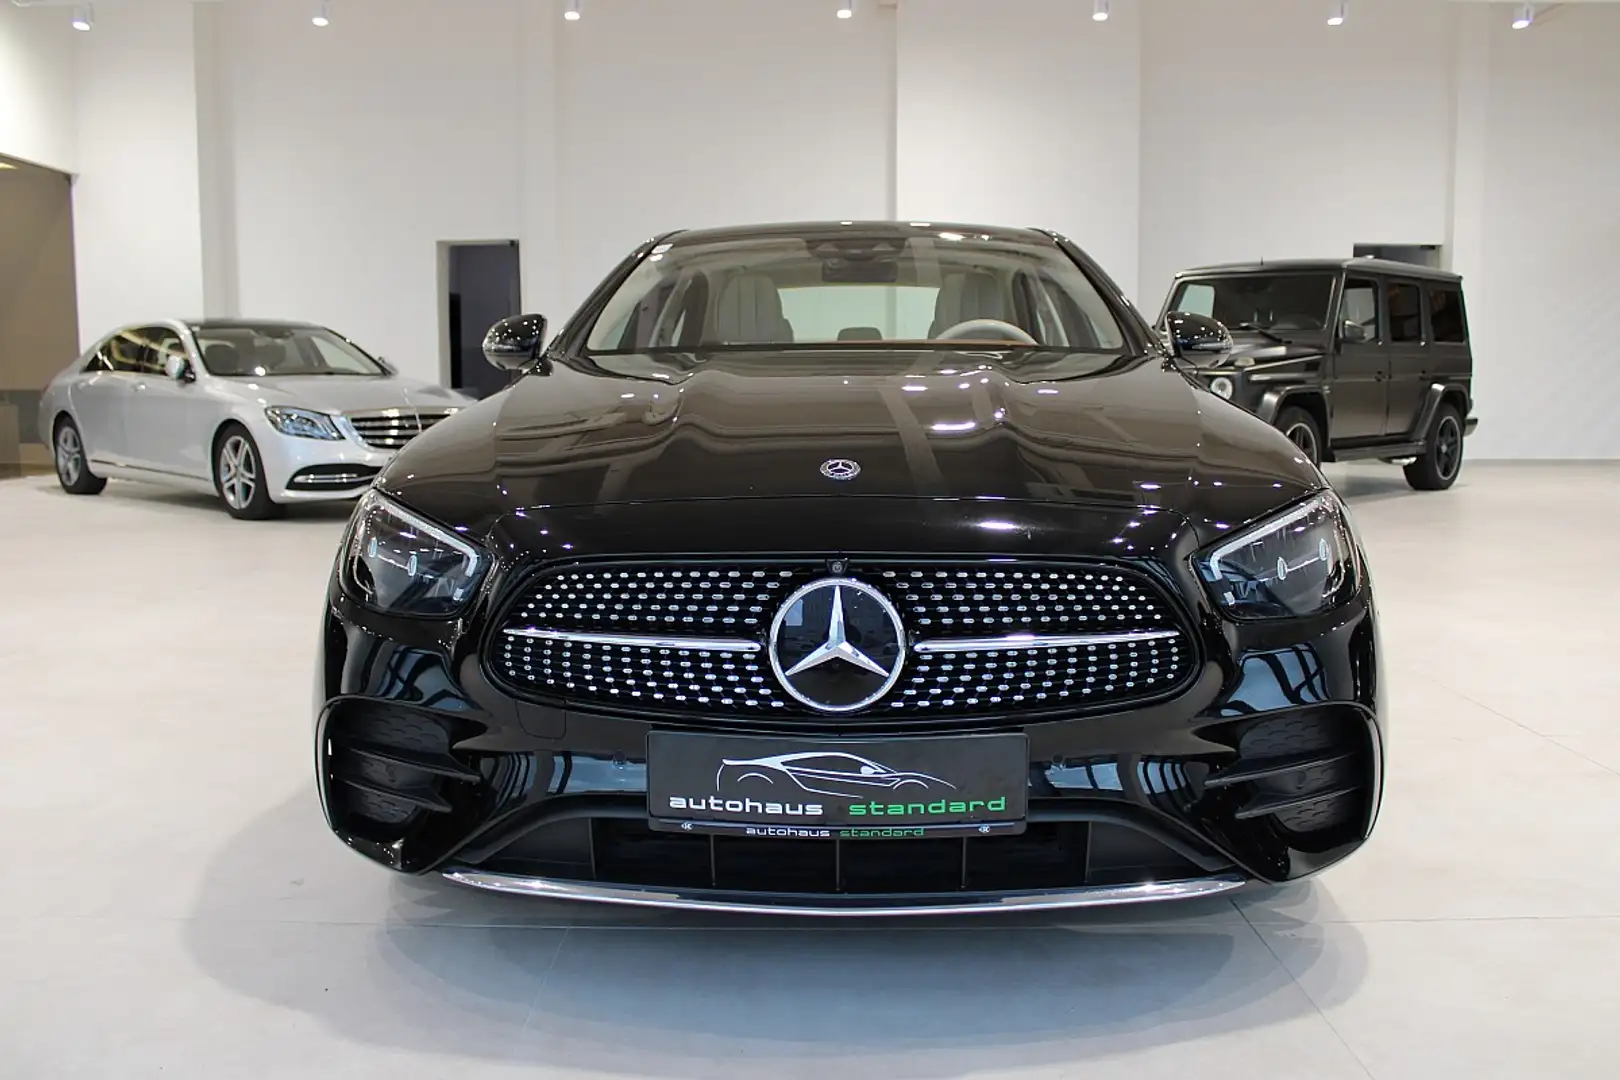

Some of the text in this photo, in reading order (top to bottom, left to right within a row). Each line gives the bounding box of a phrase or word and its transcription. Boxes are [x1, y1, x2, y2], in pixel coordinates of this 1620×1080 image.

[669, 796, 1006, 816] autohaus standard
[745, 827, 925, 837] autohaus standard
